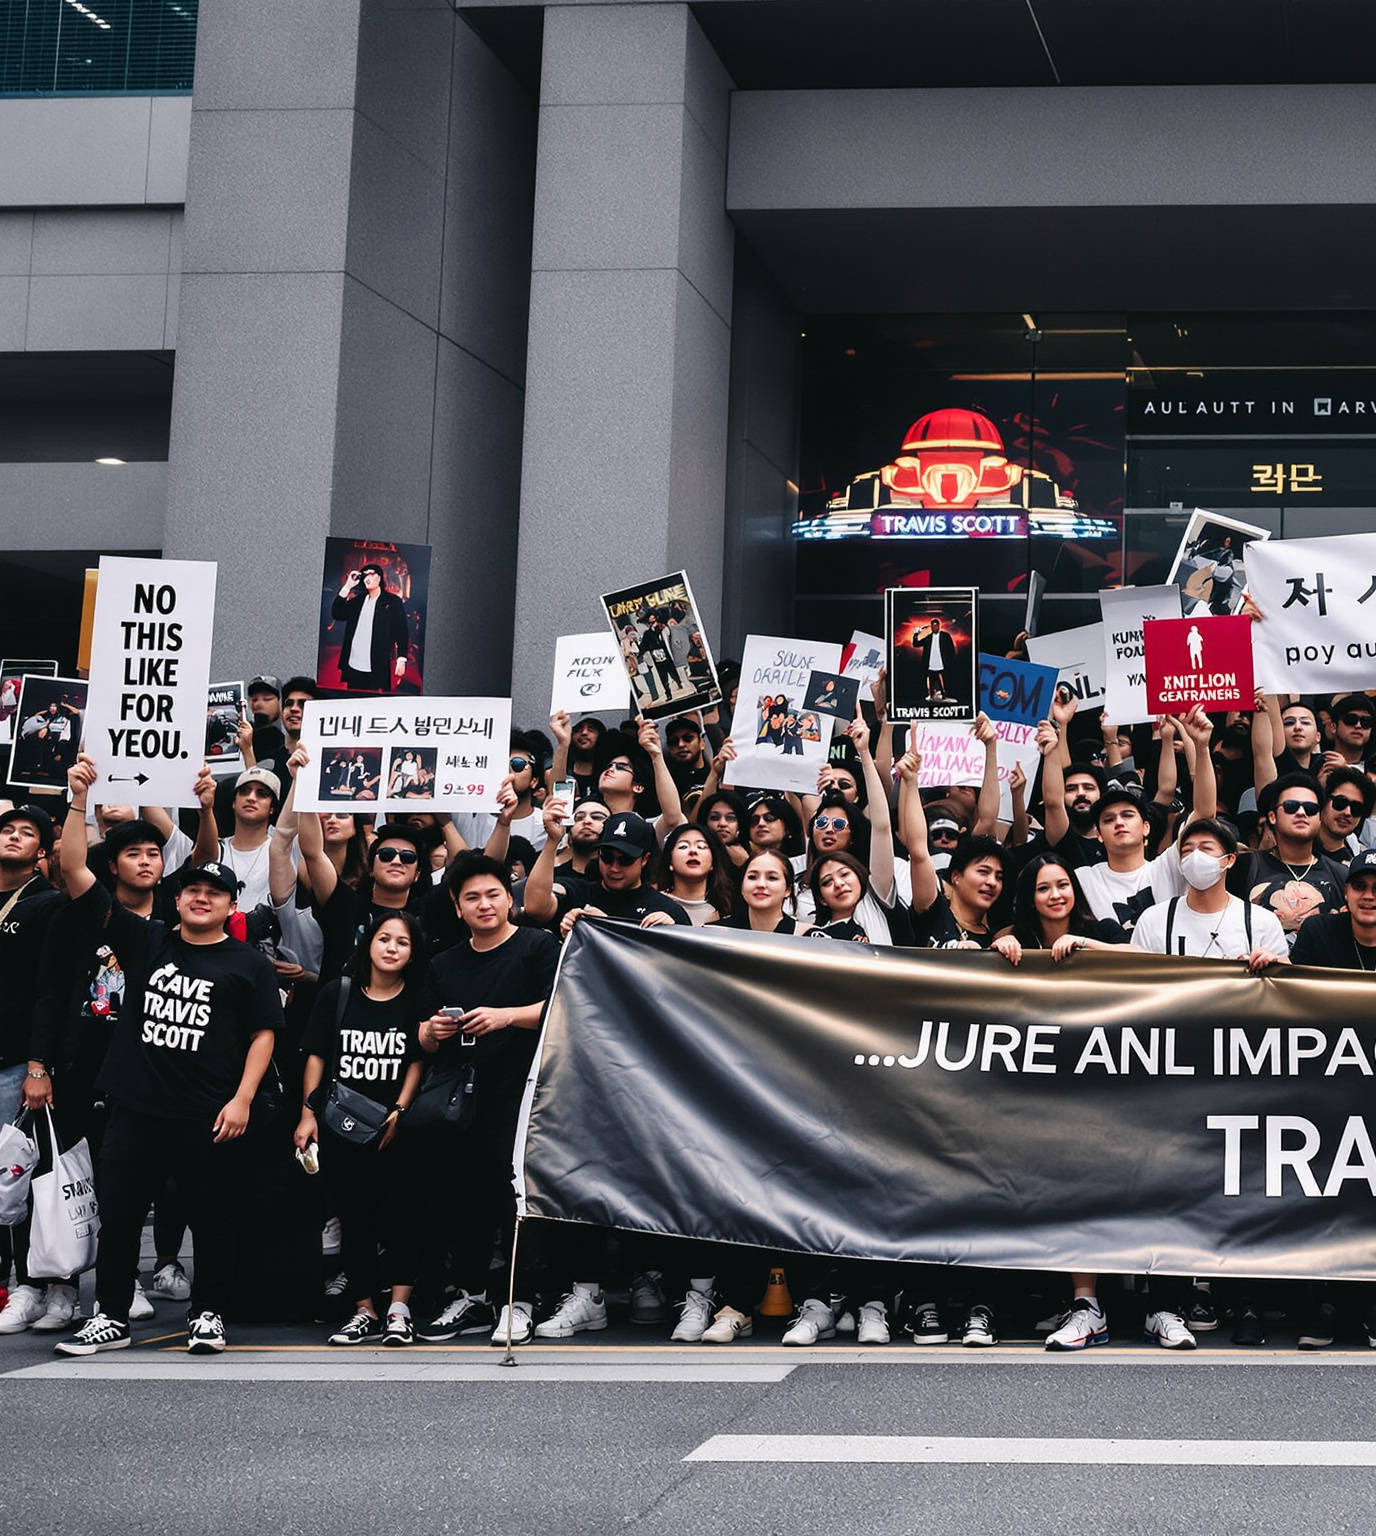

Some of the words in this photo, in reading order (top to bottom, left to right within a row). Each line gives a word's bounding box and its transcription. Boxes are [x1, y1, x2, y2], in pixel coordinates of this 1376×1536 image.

[1271, 401, 1294, 414] IN
[133, 584, 177, 615] NO
[121, 621, 183, 651] THIS
[124, 657, 179, 686] LIKE
[120, 693, 174, 723] FOR
[108, 728, 189, 760] YEOU.
[144, 991, 212, 1027] TRAVIS
[141, 1020, 205, 1052] SCOTT
[1073, 1027, 1195, 1075] ANL
[339, 1055, 402, 1081] SCOTT
